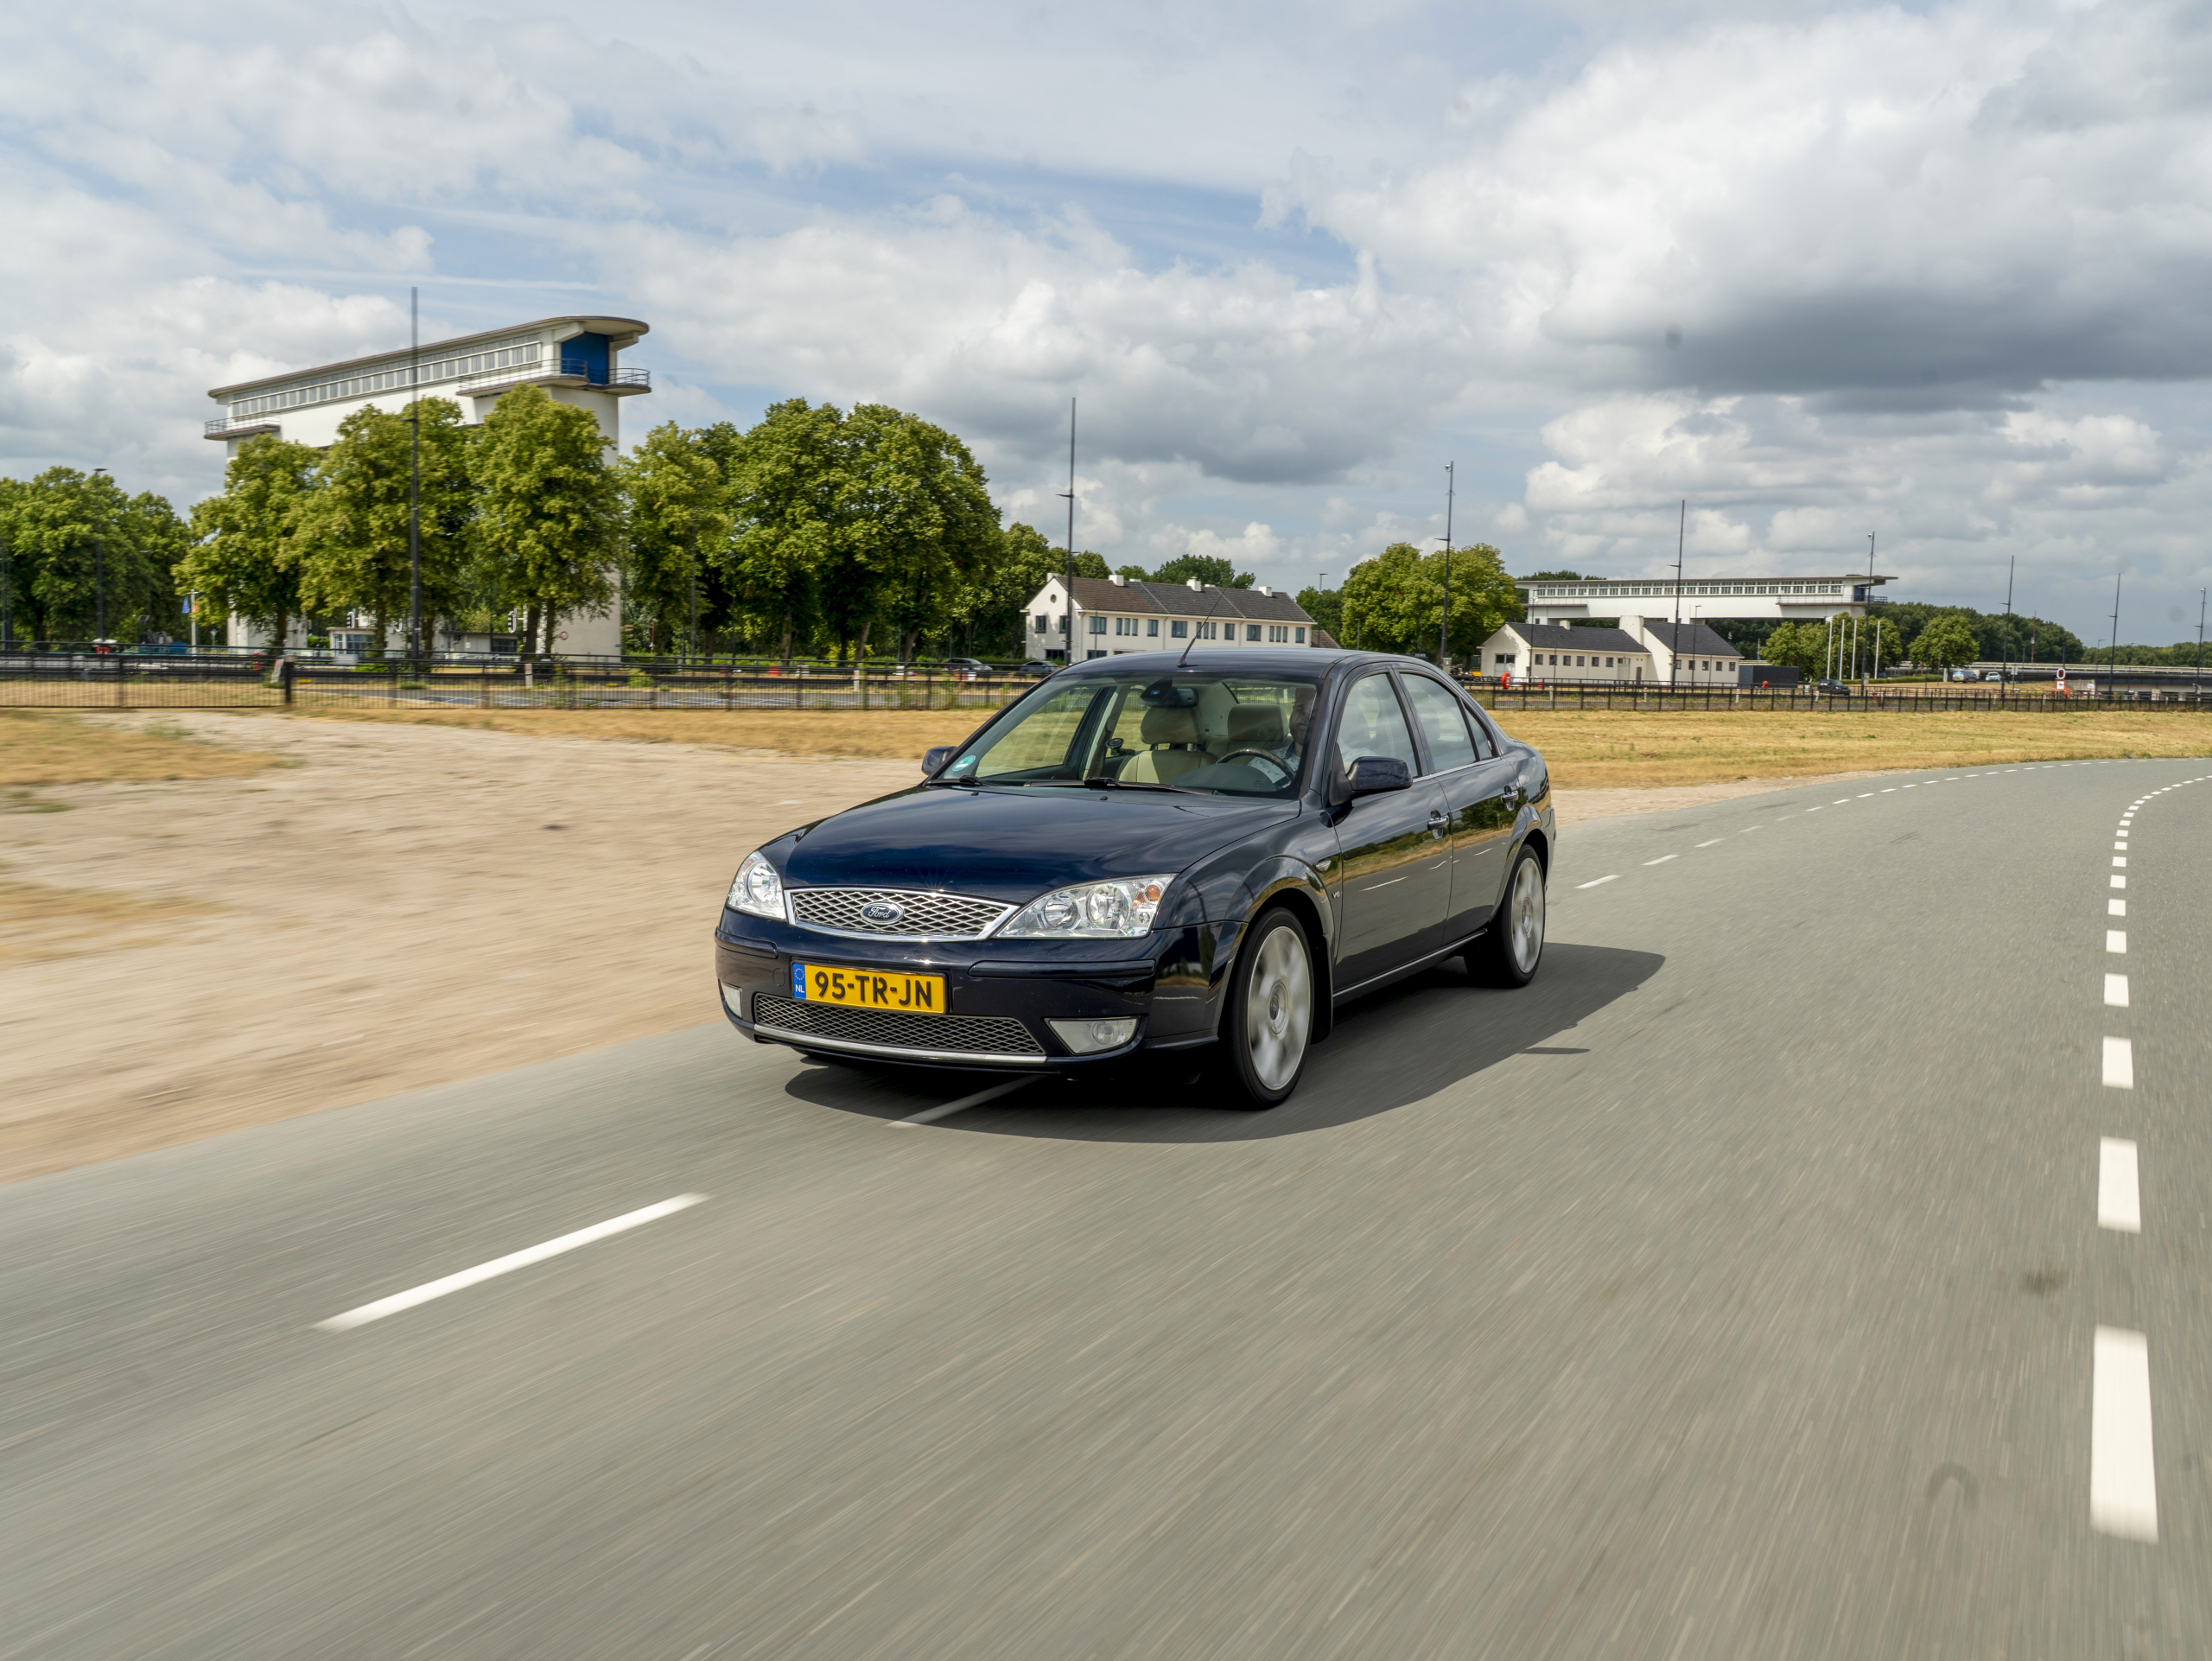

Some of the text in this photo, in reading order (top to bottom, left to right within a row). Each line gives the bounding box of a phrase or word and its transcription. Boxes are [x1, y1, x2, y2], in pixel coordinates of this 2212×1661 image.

[868, 907, 892, 919] Ford
[795, 984, 804, 993] NL
[815, 971, 931, 1007] 95-TR-JN
